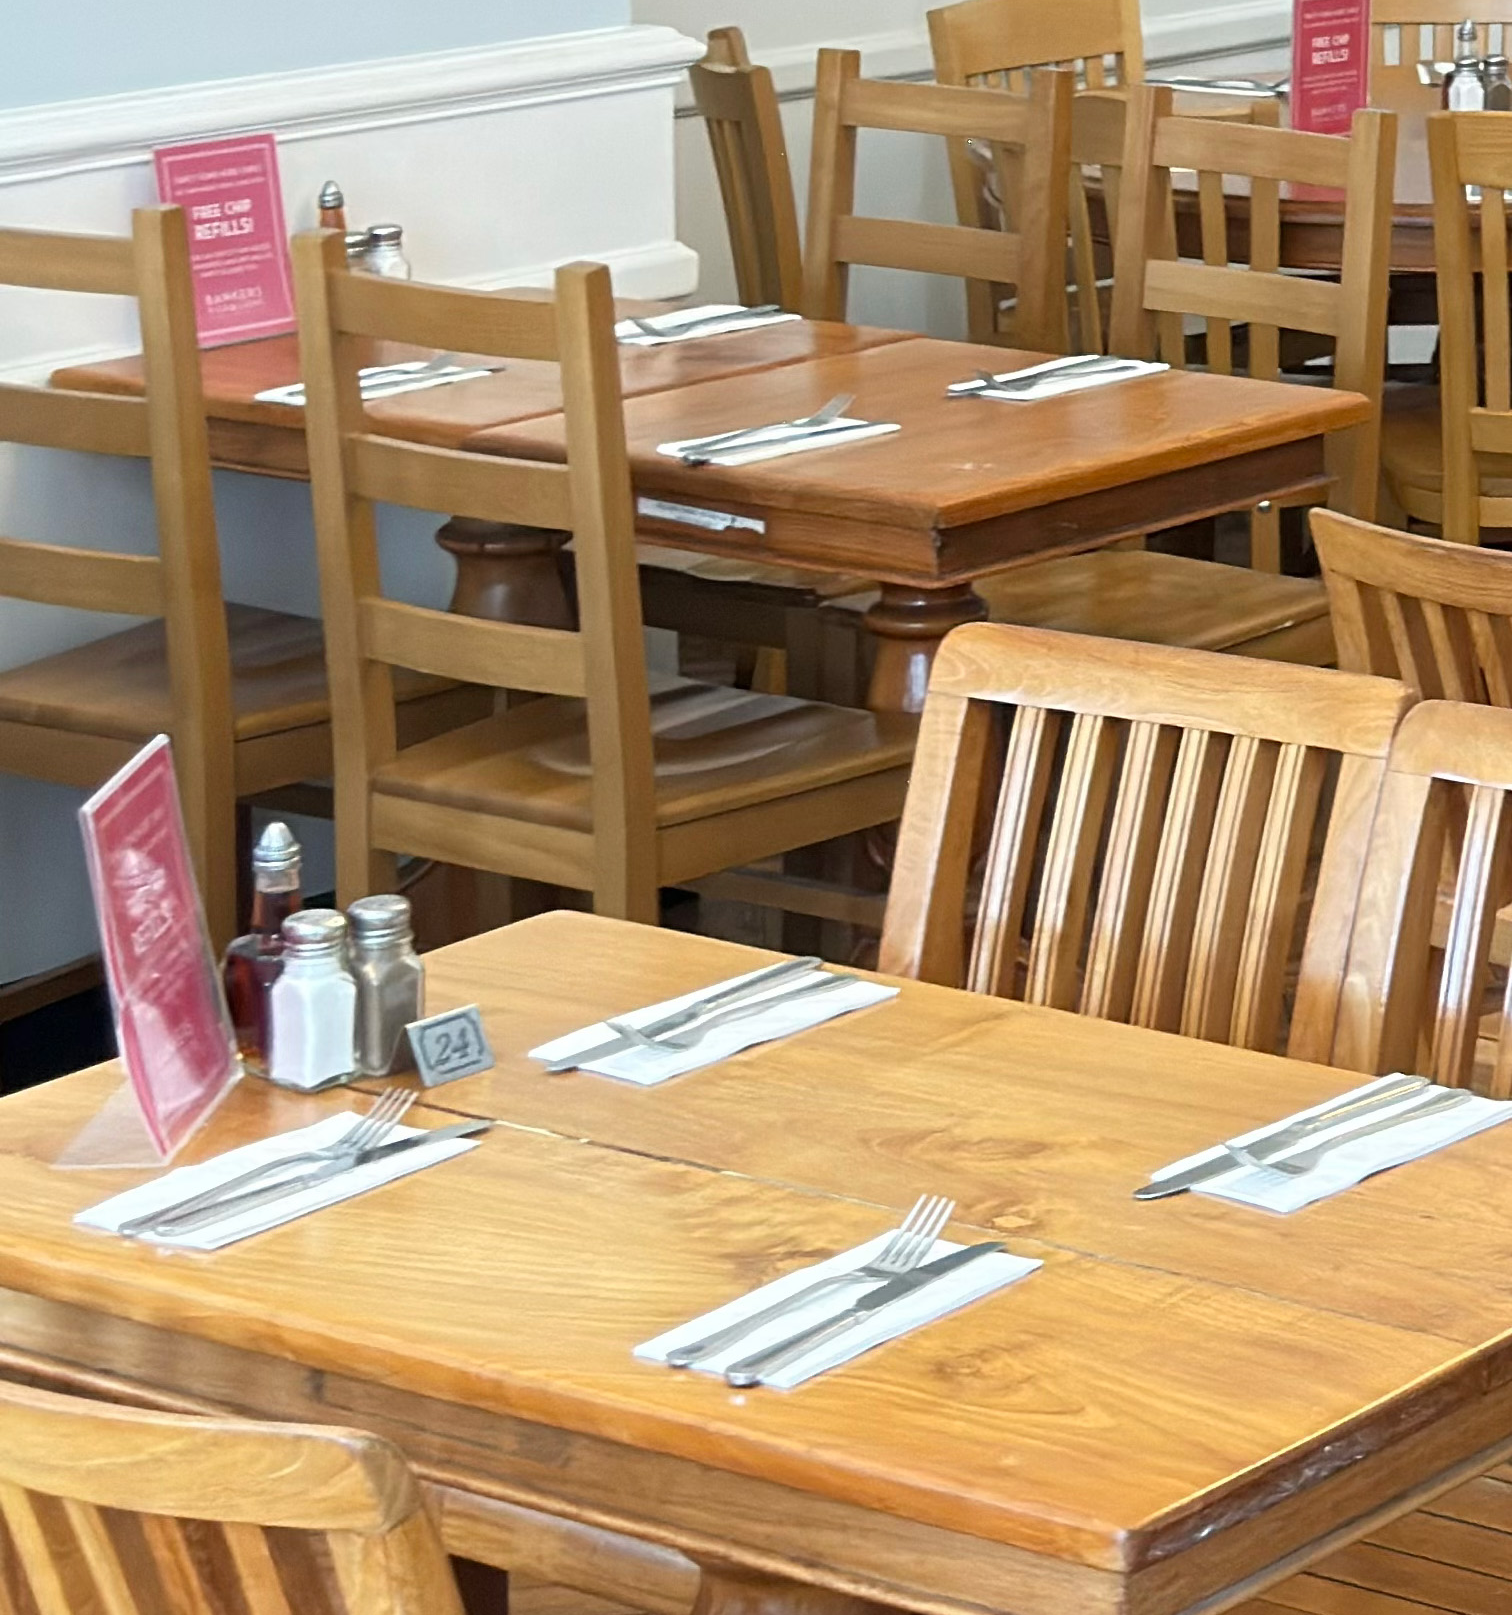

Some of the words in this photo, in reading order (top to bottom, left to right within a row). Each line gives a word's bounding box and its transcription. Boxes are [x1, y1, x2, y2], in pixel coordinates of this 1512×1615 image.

[192, 203, 222, 220] FREE
[223, 198, 252, 215] CHIP
[434, 1025, 471, 1066] 24
